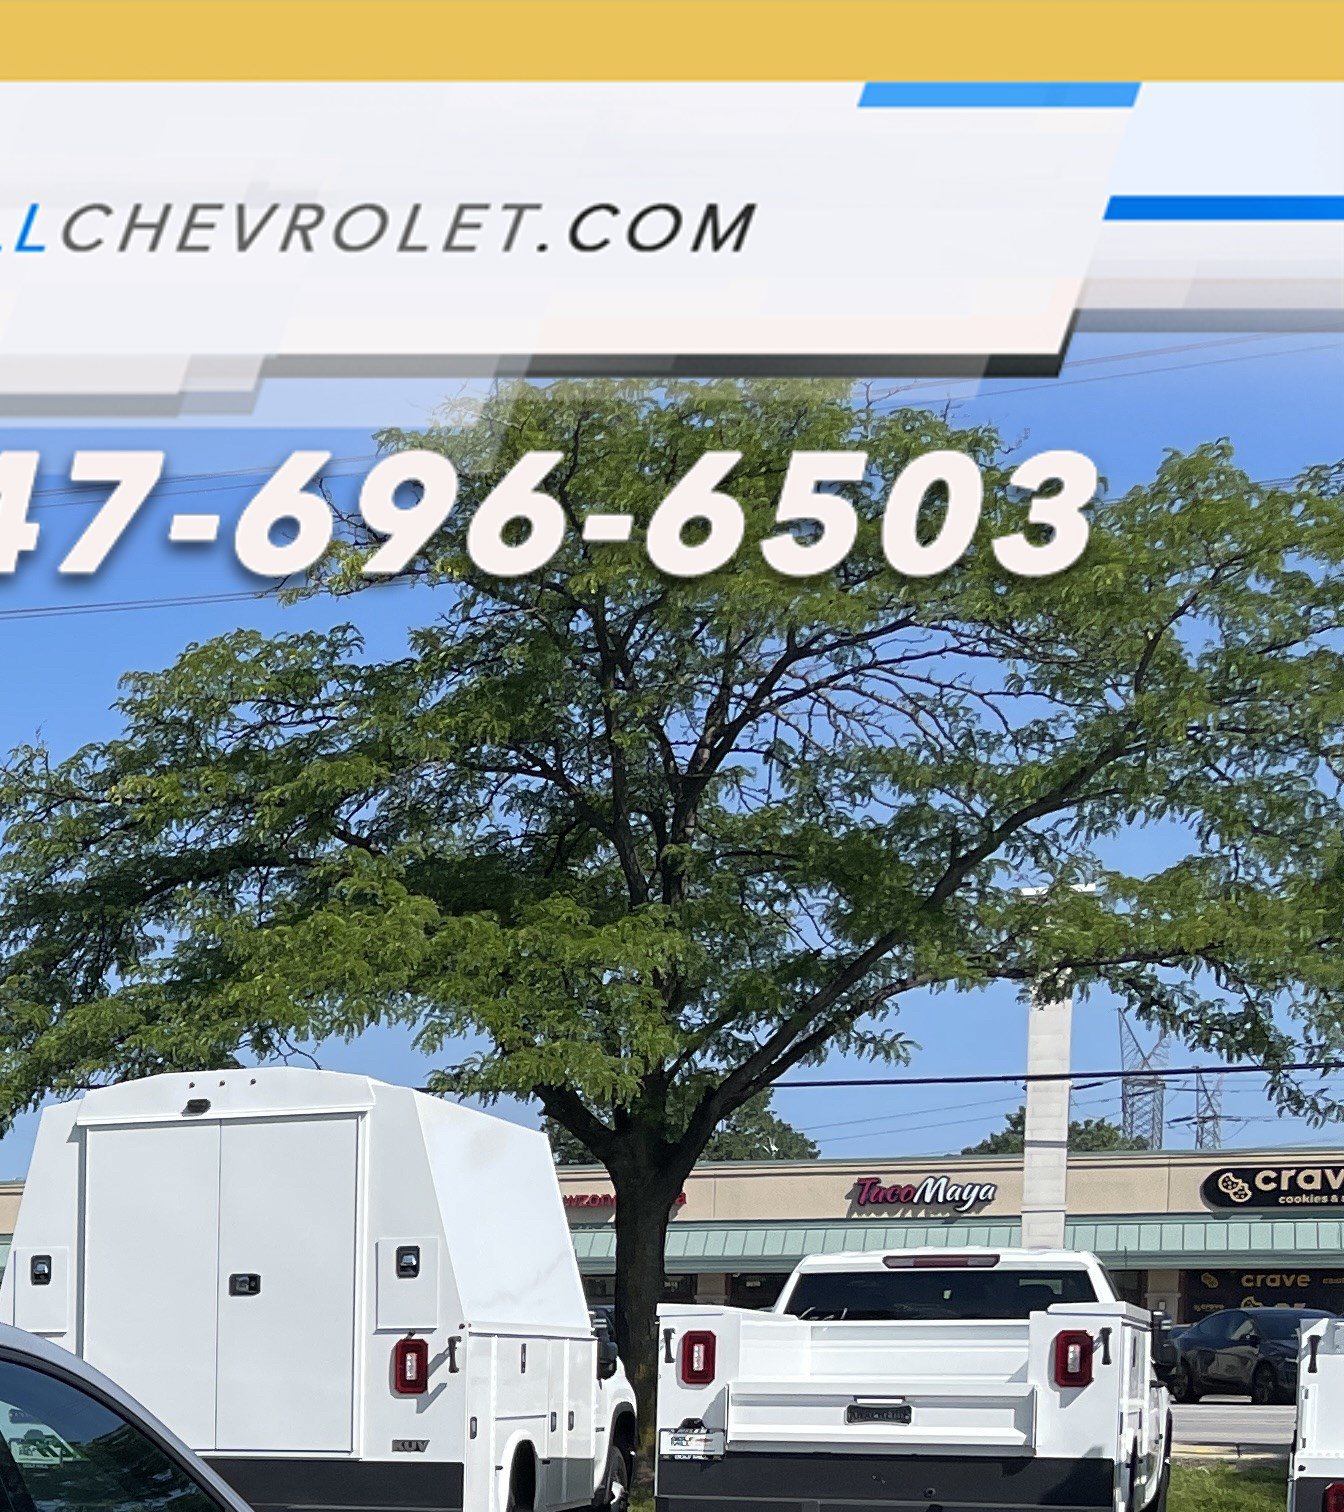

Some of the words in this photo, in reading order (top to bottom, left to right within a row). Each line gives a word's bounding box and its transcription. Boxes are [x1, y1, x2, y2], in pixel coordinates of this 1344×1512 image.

[1254, 1168, 1344, 1192] crav
[1278, 1194, 1327, 1204] cookies
[1241, 1273, 1311, 1288] crave
